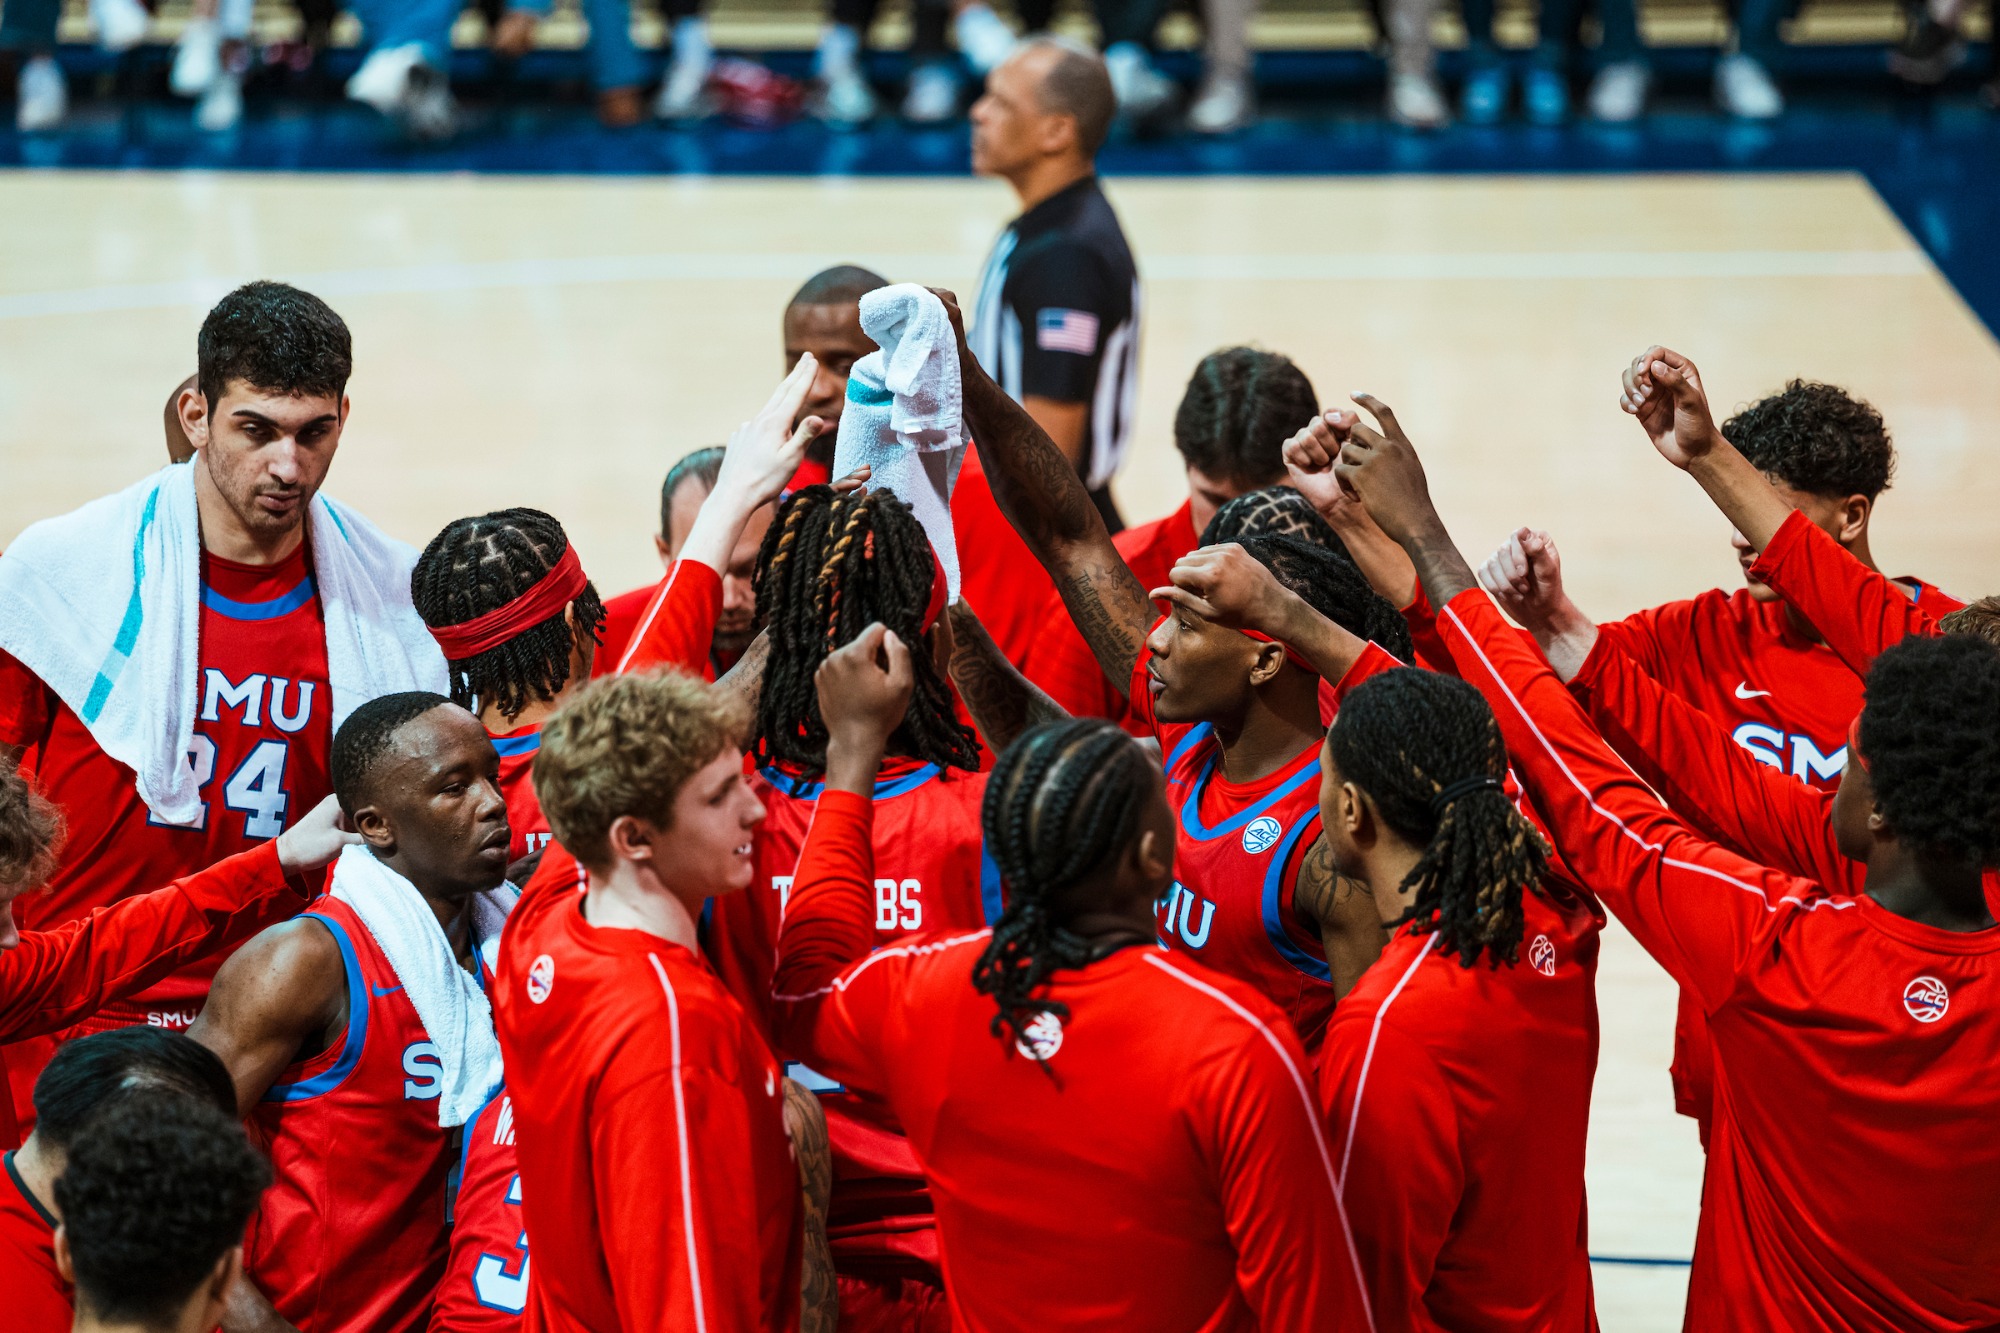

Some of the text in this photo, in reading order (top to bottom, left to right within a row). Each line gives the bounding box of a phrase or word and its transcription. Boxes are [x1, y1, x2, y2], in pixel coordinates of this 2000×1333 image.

[1077, 570, 1099, 598] That
[201, 667, 316, 733] MU
[1732, 721, 1849, 786] SM
[772, 876, 922, 930] TBS
[1154, 880, 1217, 950] MU
[147, 1009, 197, 1028] SMU
